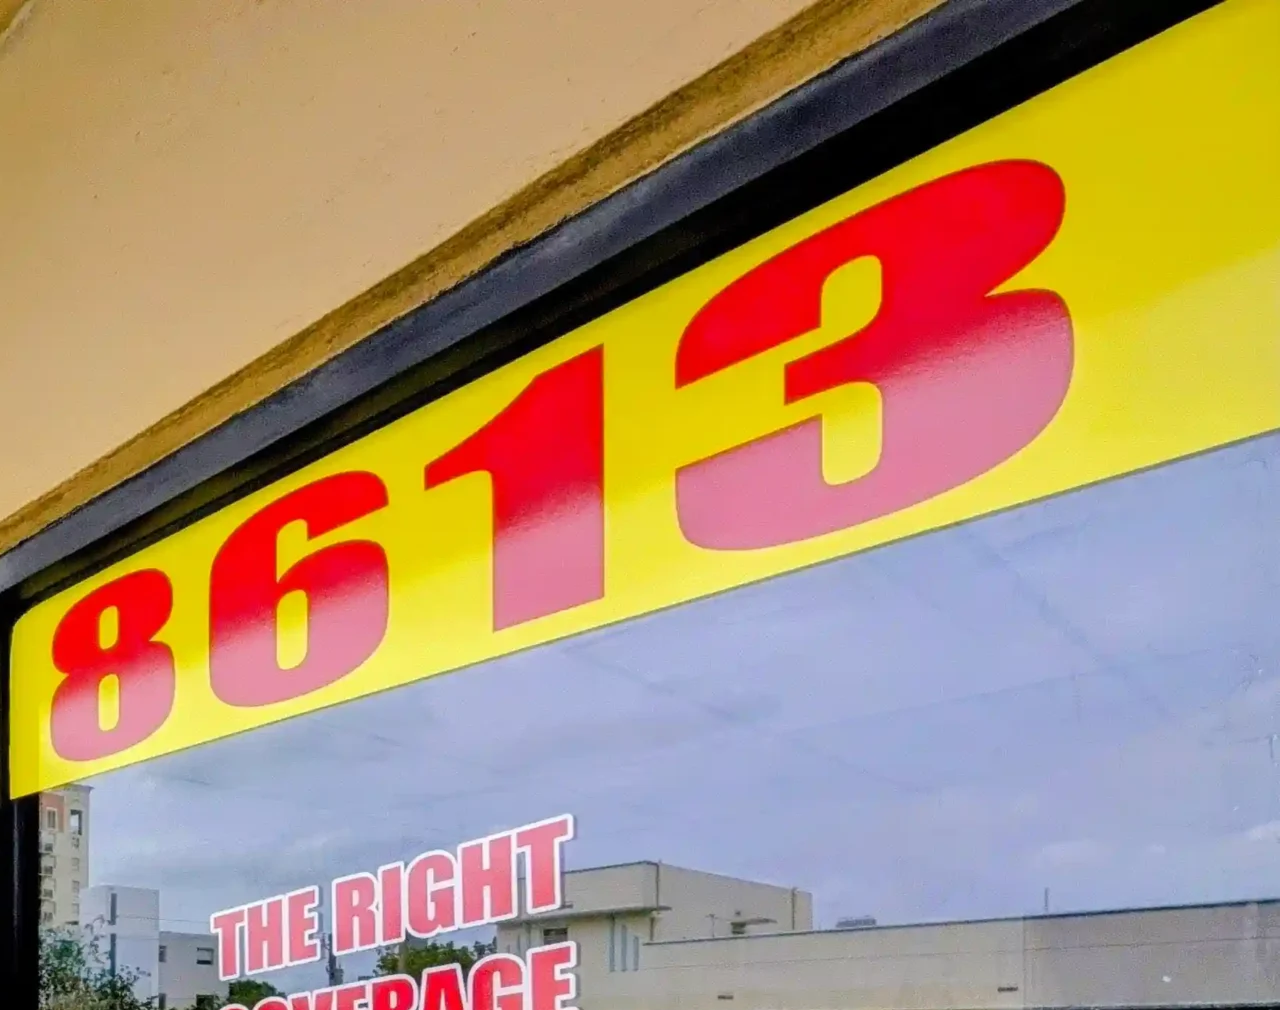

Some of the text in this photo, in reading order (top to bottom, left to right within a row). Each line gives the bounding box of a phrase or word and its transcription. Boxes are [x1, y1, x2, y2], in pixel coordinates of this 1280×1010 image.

[50, 158, 1075, 762] 8613
[211, 814, 573, 981] THE RIGHT
